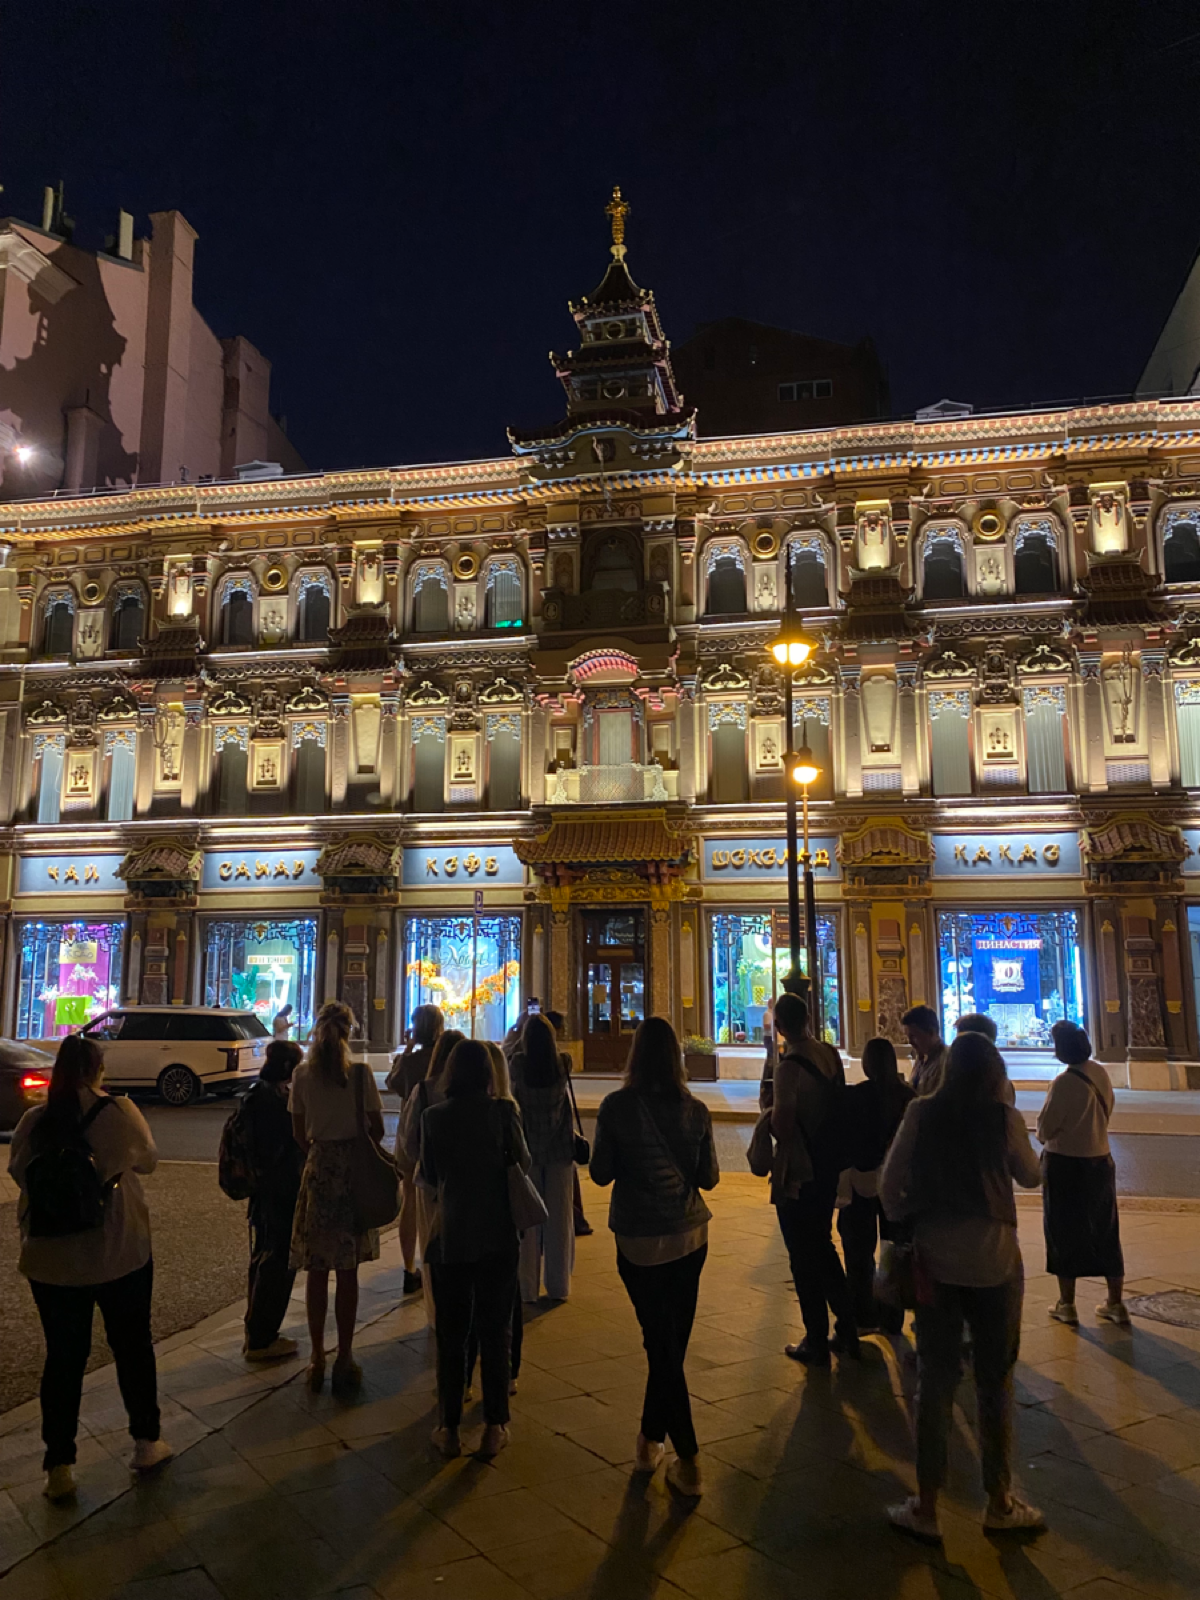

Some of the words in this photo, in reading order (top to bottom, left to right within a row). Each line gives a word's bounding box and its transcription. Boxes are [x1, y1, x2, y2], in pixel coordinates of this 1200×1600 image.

[426, 851, 499, 875] КОФЕ
[954, 843, 1061, 866] КАКАО
[46, 862, 100, 883] ЧАЙ
[218, 858, 305, 879] САХАР
[977, 939, 1042, 950] ДИНАСТИЯ
